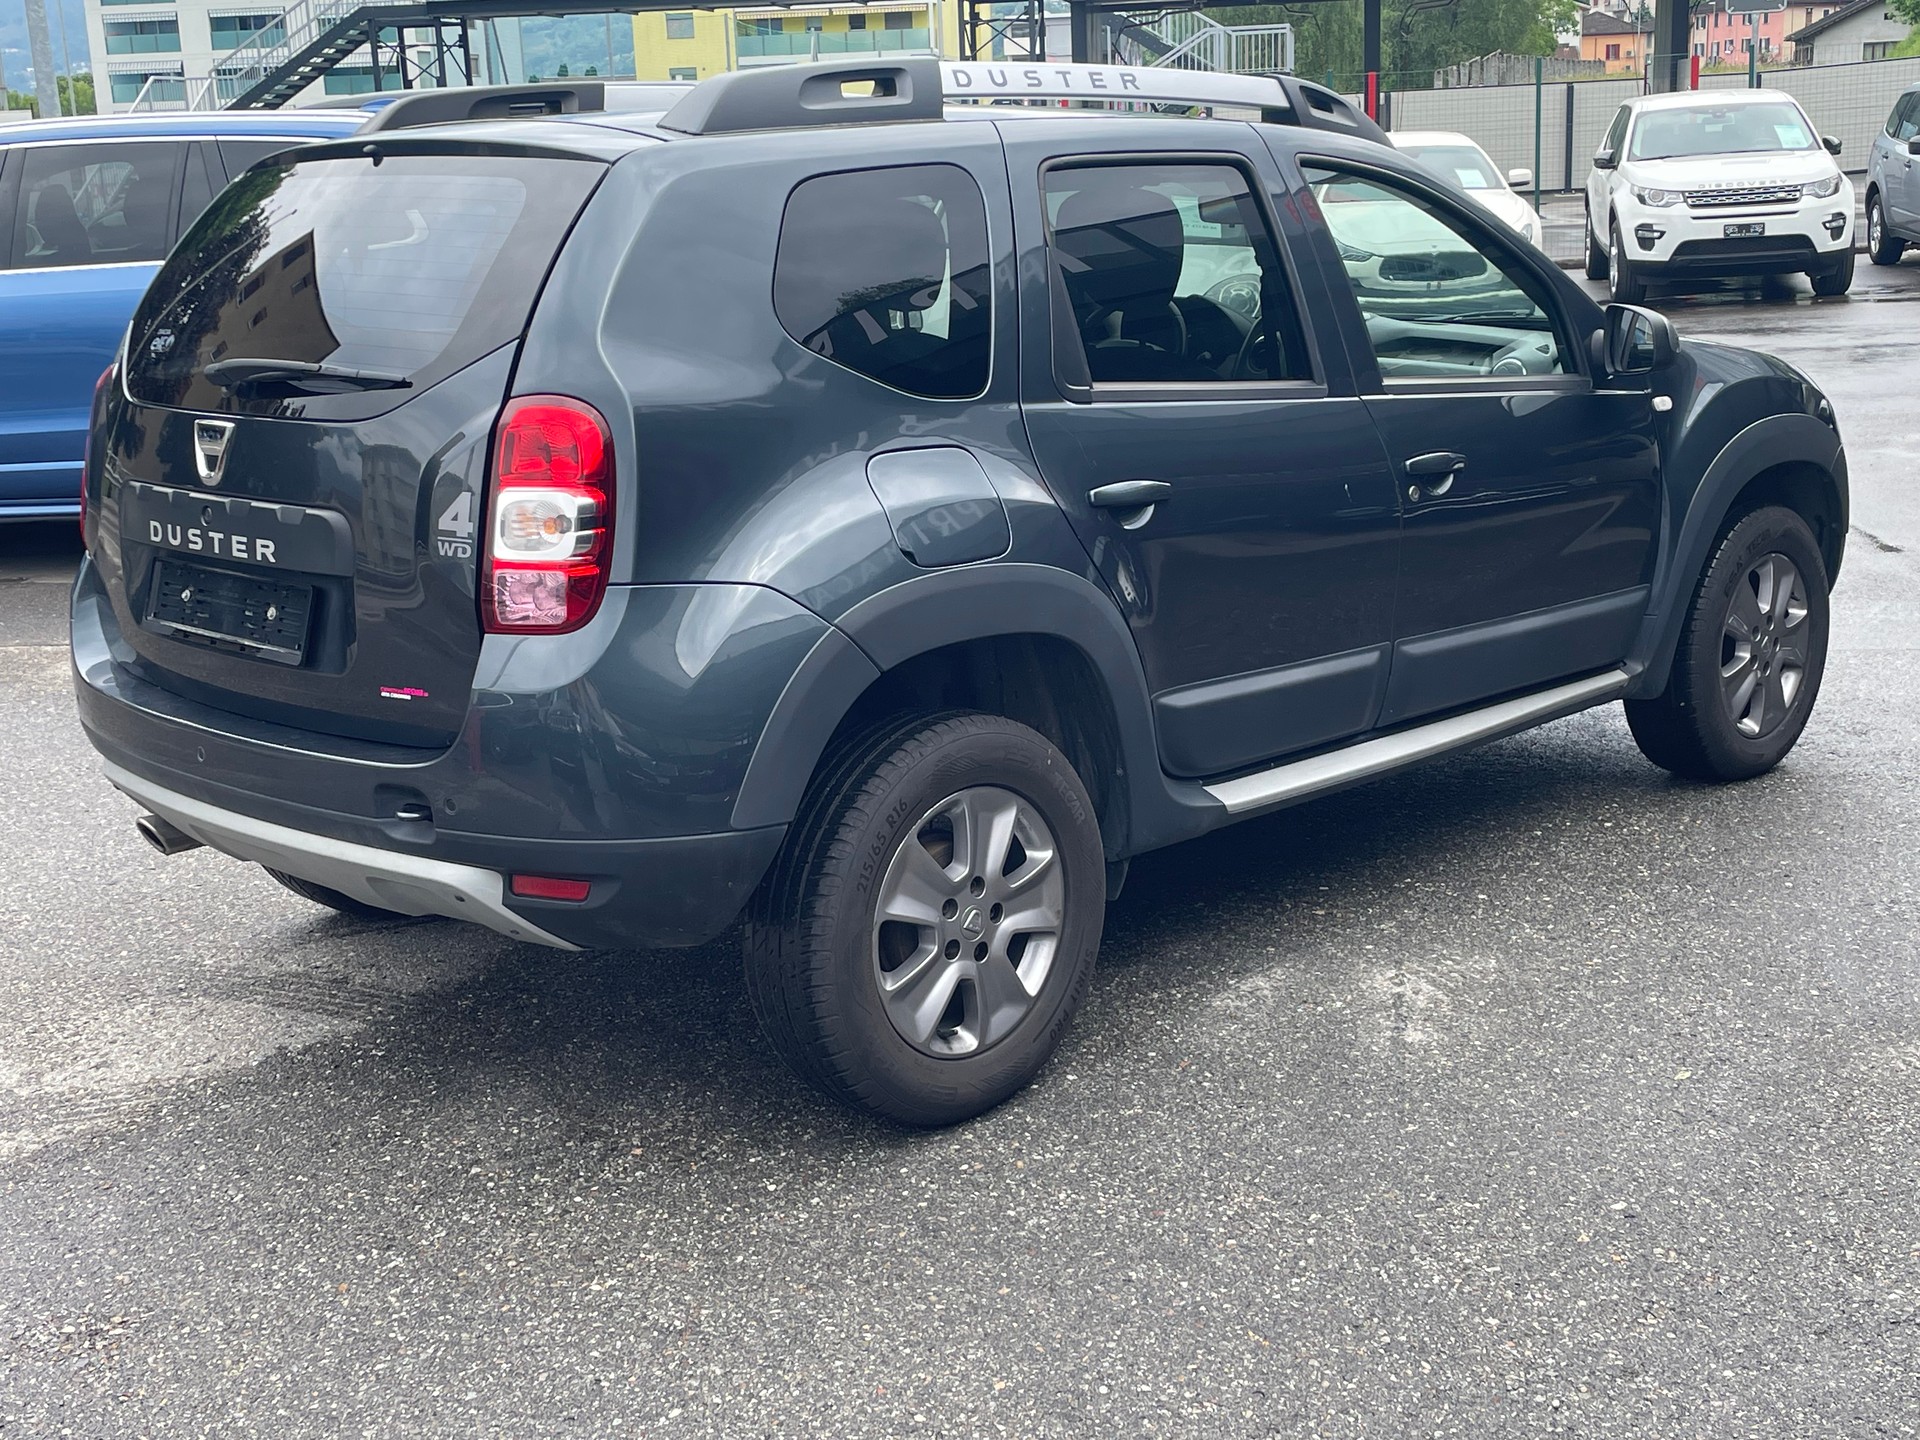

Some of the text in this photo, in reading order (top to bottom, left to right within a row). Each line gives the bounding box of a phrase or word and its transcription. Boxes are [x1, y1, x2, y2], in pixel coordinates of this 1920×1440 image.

[952, 69, 1140, 90] DUSTER
[1698, 179, 1788, 189] DISCOVERY
[438, 491, 473, 538] 4
[149, 520, 276, 563] DUSTER
[437, 541, 472, 558] WD
[857, 798, 908, 893] 215/65 R16
